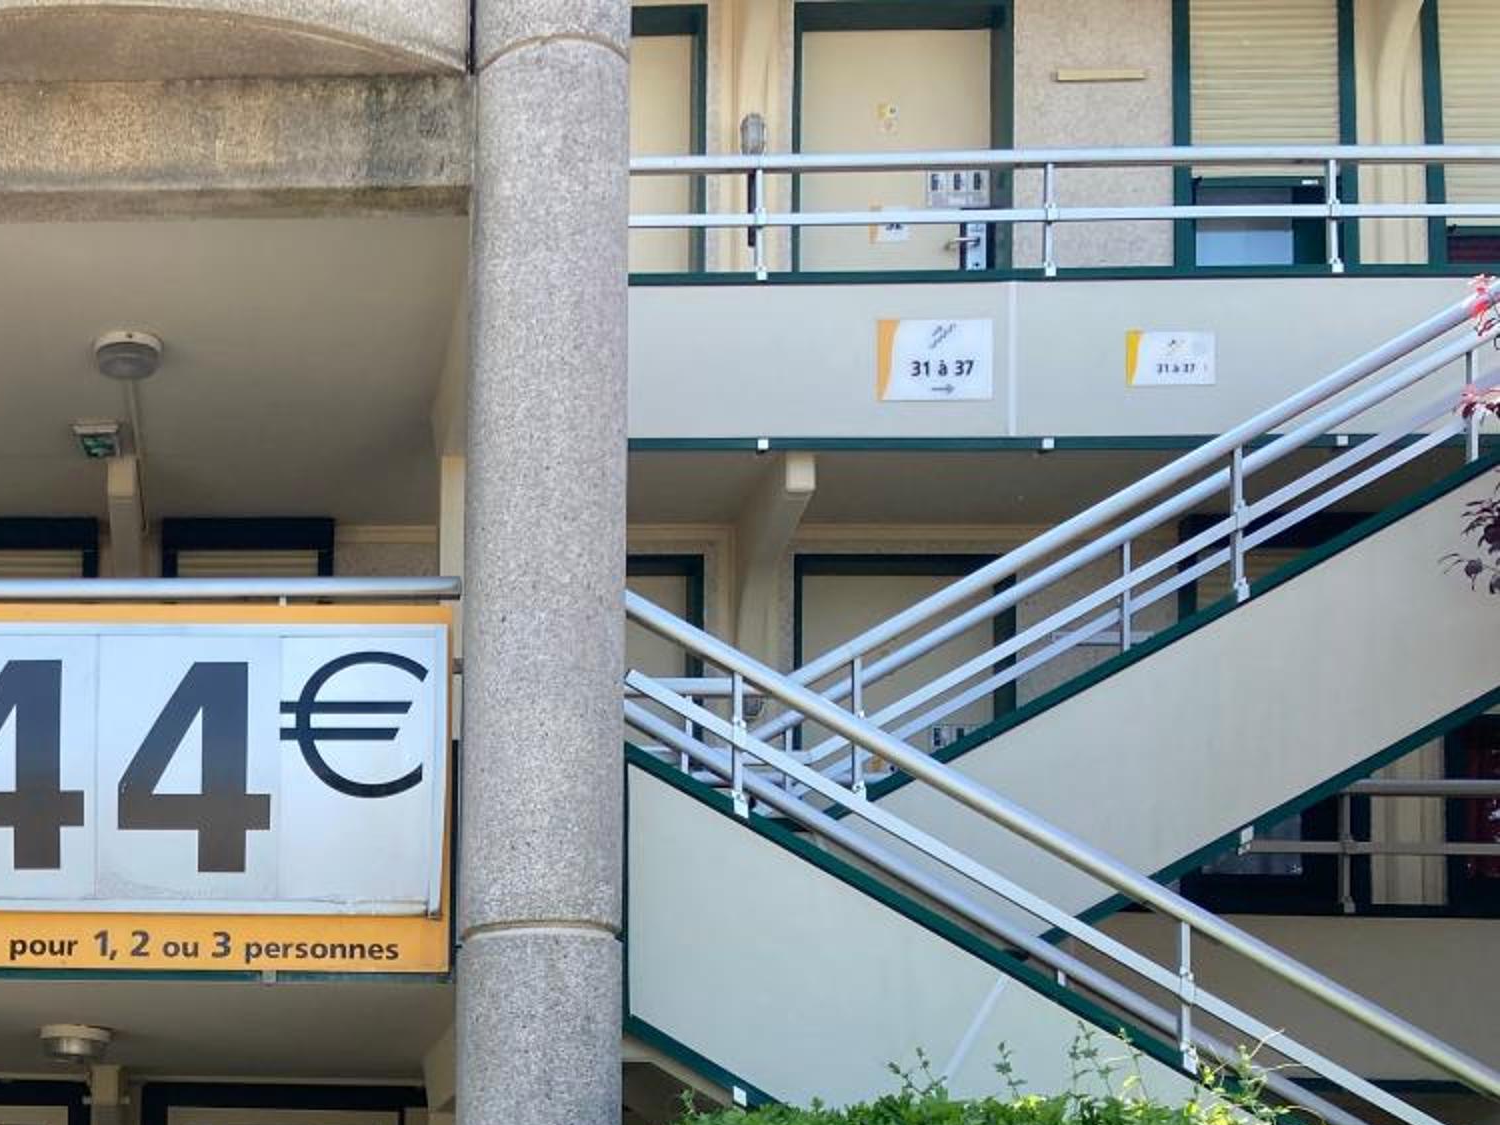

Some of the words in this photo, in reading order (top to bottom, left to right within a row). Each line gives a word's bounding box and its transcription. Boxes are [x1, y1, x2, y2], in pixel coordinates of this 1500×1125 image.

[911, 360, 931, 377] 31
[937, 359, 948, 377] à
[954, 360, 975, 377] 37
[9, 936, 79, 960] pour
[162, 937, 200, 959] ou
[211, 931, 232, 958] 3
[244, 938, 400, 965] personnes
